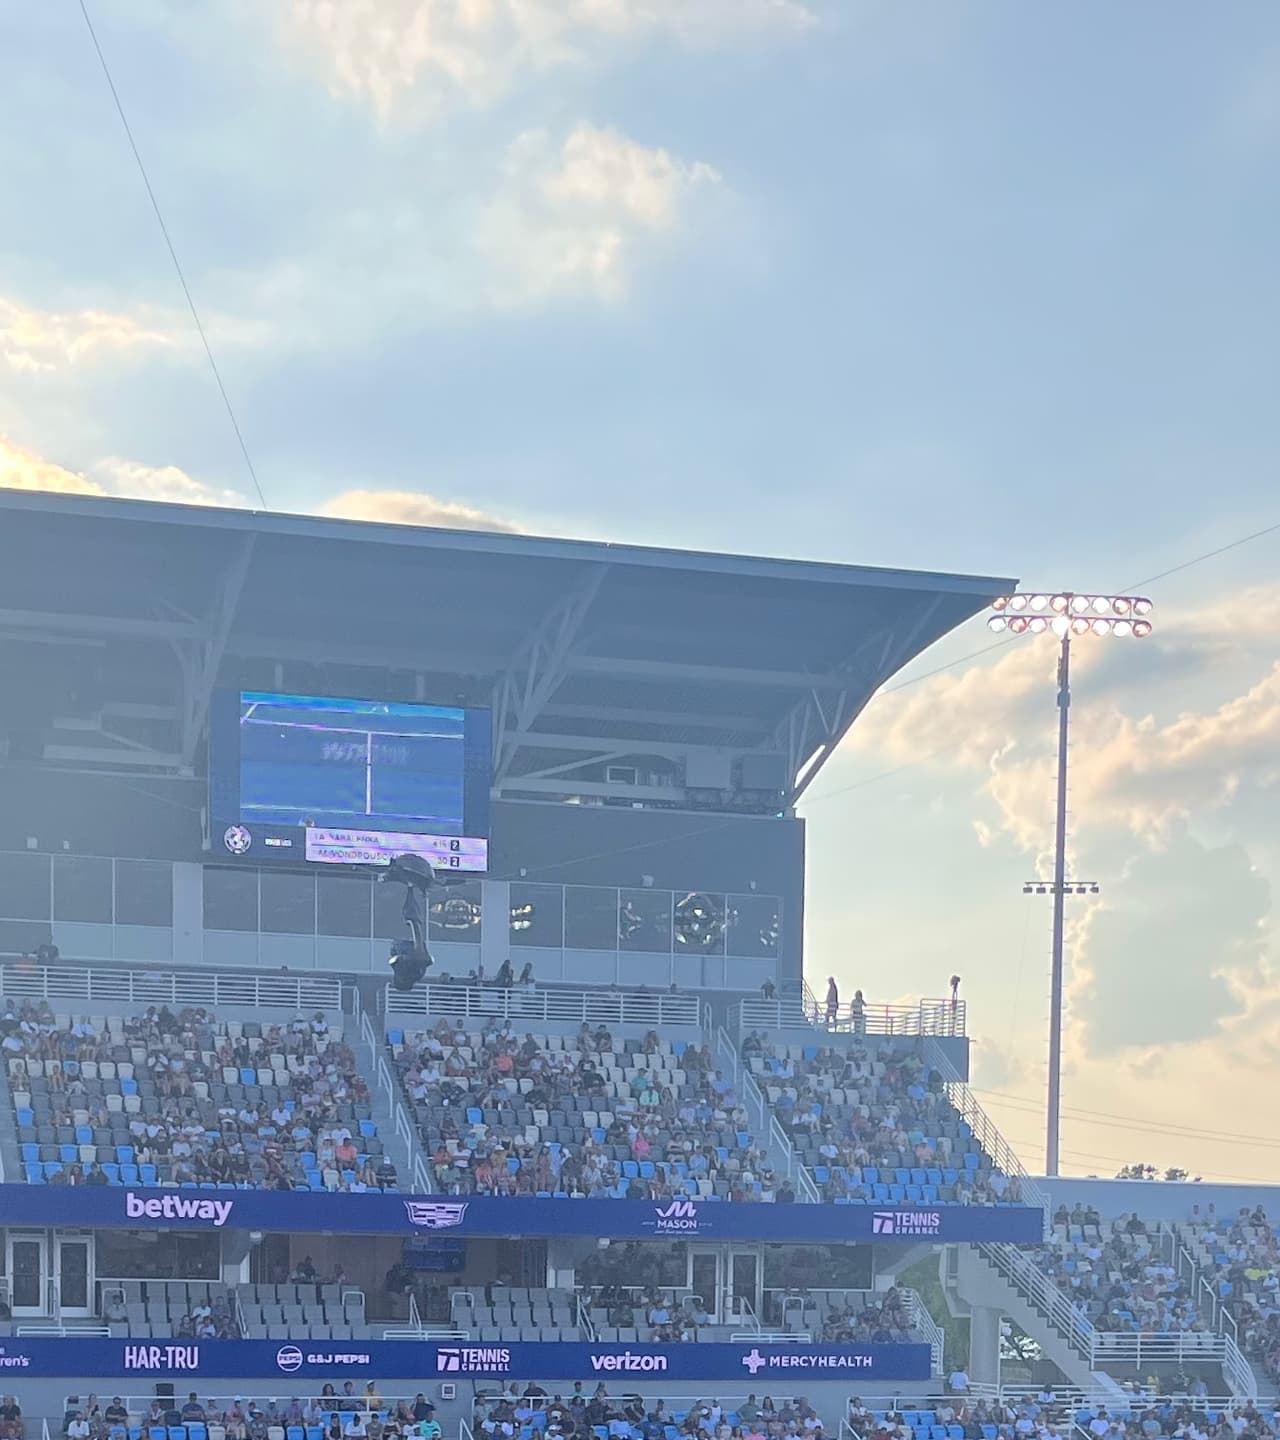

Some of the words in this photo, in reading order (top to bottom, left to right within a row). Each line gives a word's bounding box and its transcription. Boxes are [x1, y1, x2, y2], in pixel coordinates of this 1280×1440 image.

[126, 1192, 233, 1226] betway
[657, 1220, 697, 1229] MASON
[895, 1212, 940, 1226] TENNIS
[895, 1227, 940, 1235] CHANNEL
[125, 1346, 198, 1369] HAR-TRU
[307, 1355, 332, 1364] G&J
[334, 1355, 370, 1364] PEPSI
[461, 1349, 510, 1363] TENNIS
[591, 1351, 667, 1370] verizon
[769, 1356, 873, 1367] MERCYHEALTH
[461, 1362, 510, 1372] CHANNEL
